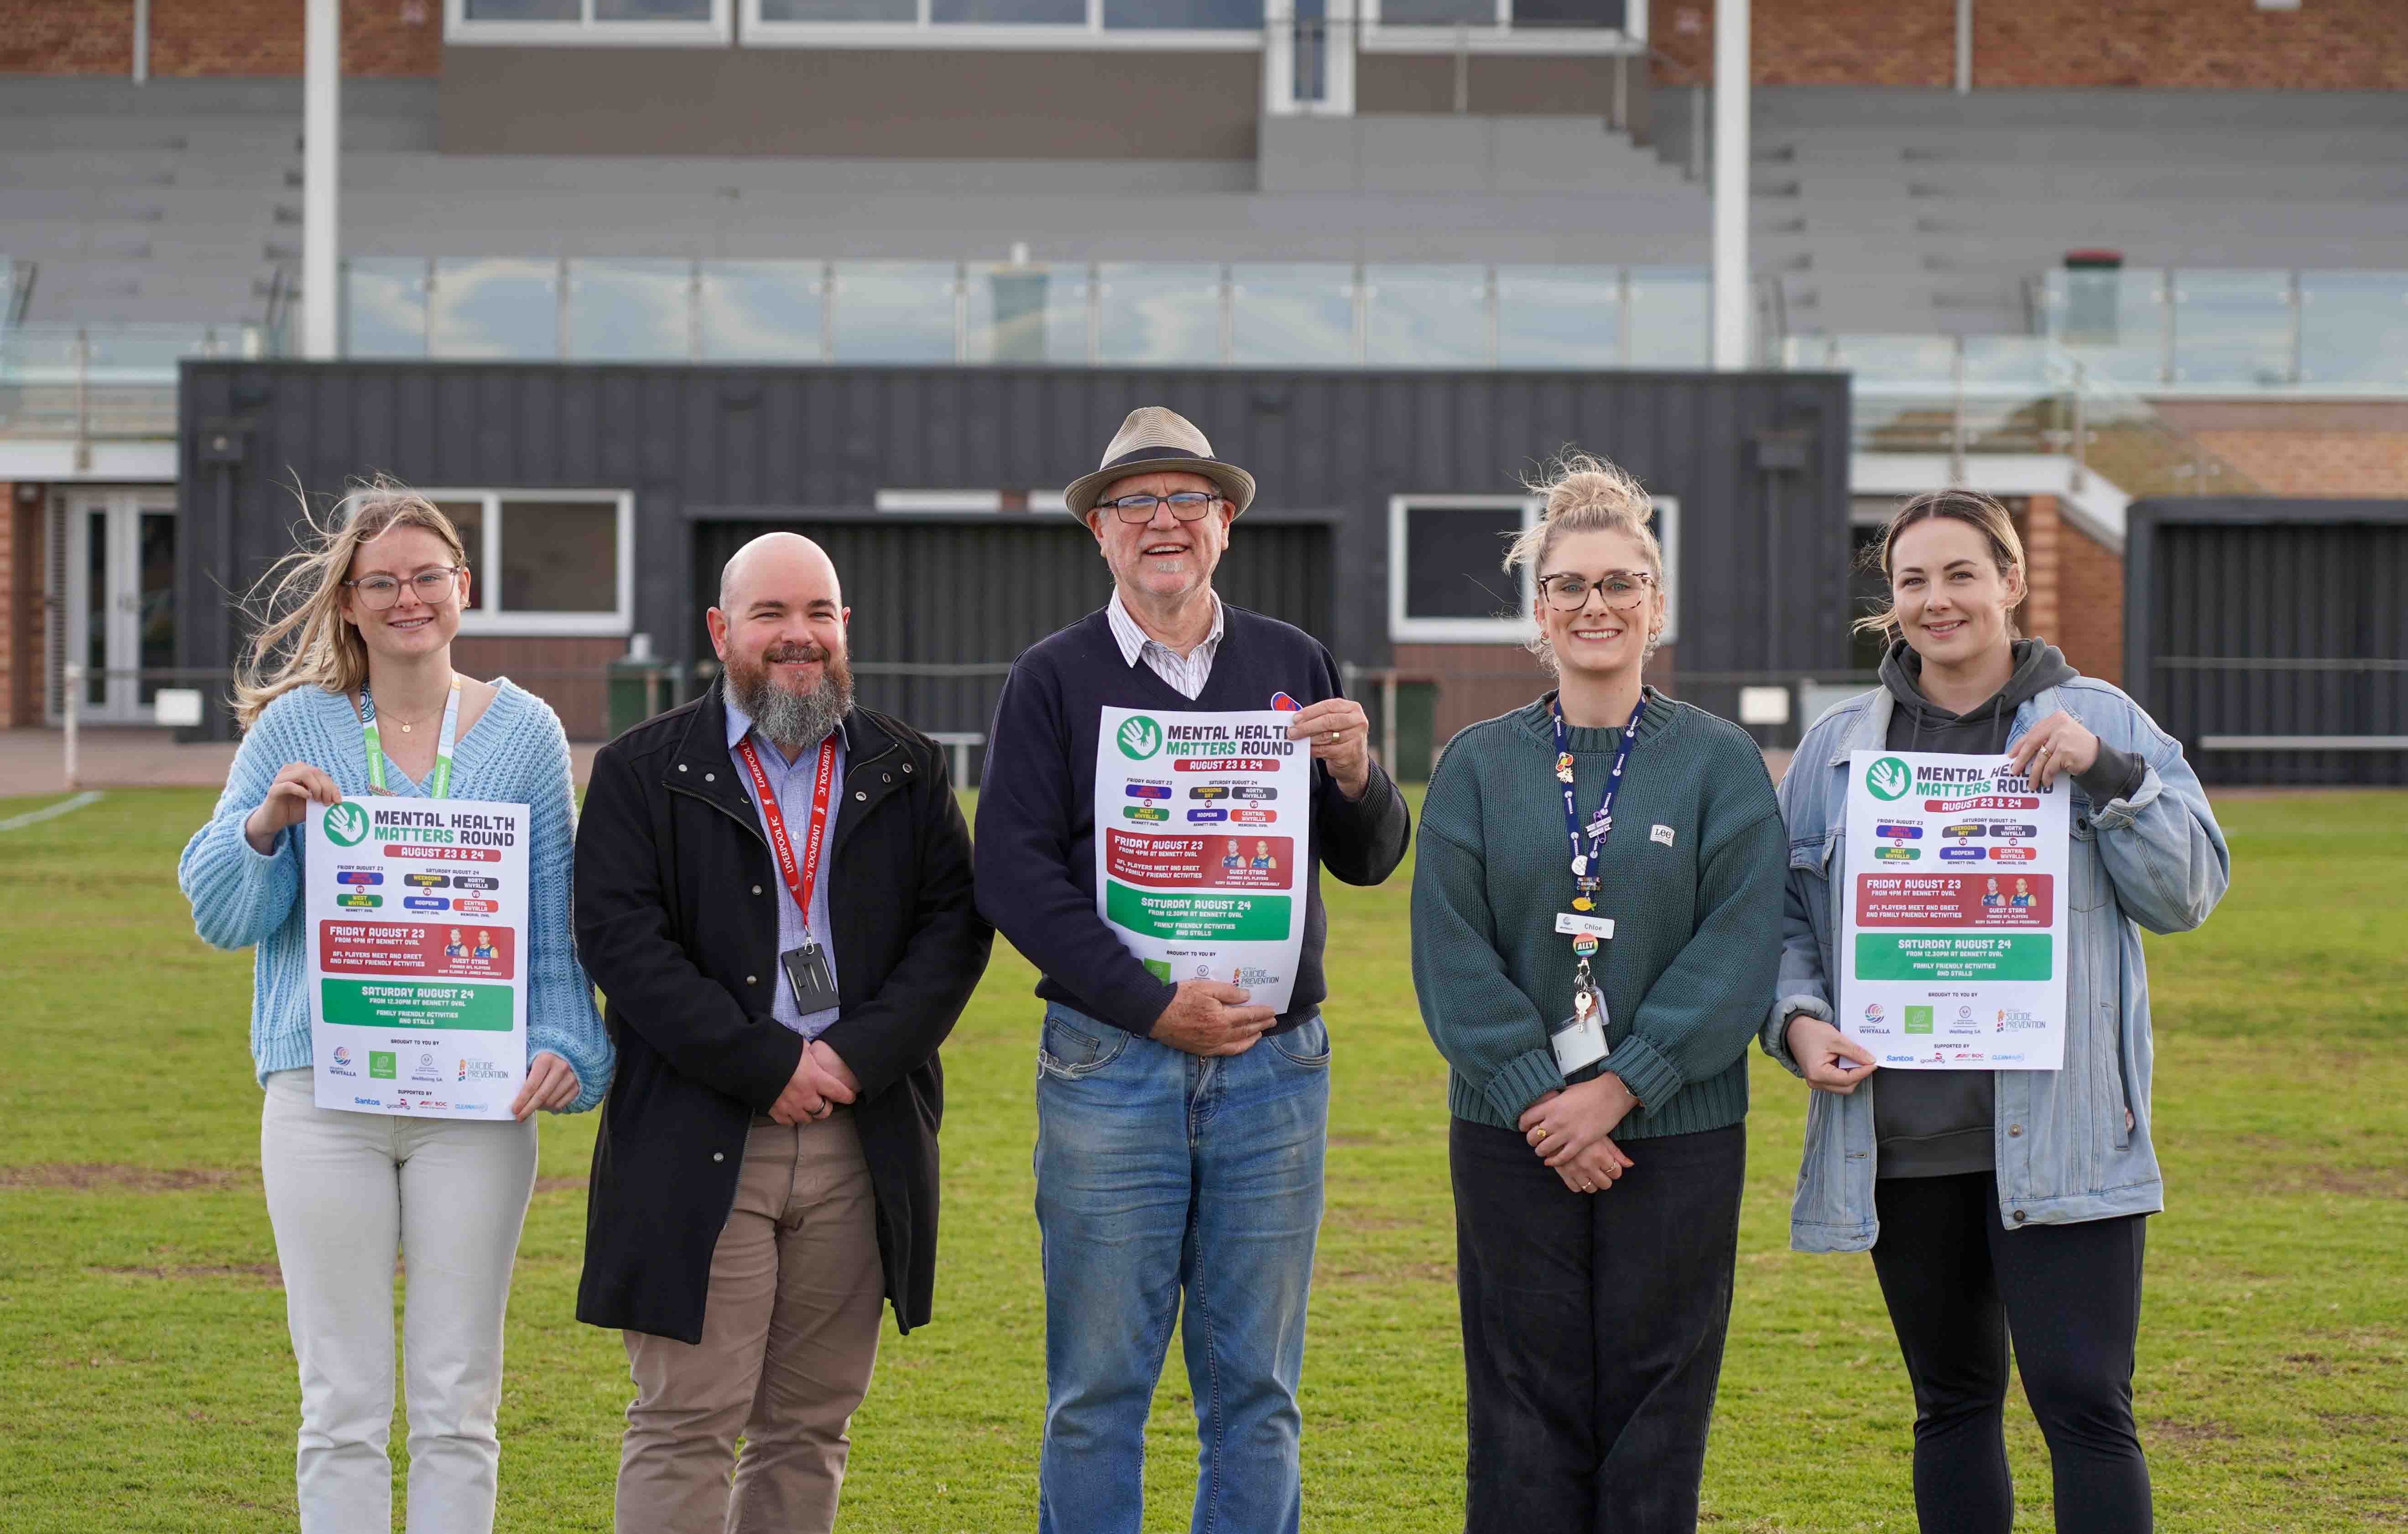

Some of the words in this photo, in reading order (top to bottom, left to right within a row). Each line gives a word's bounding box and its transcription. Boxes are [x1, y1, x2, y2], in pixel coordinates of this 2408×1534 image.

[1168, 725, 1229, 740] MENTAL
[1166, 741, 1235, 755] MATTERS
[1241, 741, 1293, 756] ROUND
[744, 747, 765, 788] LIVERPOOL
[820, 745, 832, 785] LIVERPOOL
[1190, 761, 1224, 770] AUGUST
[1226, 761, 1237, 769] 23
[1240, 761, 1246, 769] &
[1250, 760, 1262, 769] 24
[1917, 767, 1985, 782] MENTAL
[818, 786, 826, 796] FC
[1916, 781, 1991, 797] MATTERS
[1942, 799, 1978, 810] AUGUST
[1981, 798, 1993, 807] 23
[1997, 798, 2004, 807] &
[2008, 798, 2022, 807] 24
[375, 810, 444, 827] MENTAL
[452, 814, 514, 831] HEALTH
[771, 815, 780, 826] FC
[375, 827, 454, 843] MATTERS
[460, 831, 514, 846] ROUND
[1654, 828, 1671, 839] Lee
[808, 824, 821, 869] LIVERPOOL
[1115, 835, 1149, 849] FRIDAY
[1152, 840, 1188, 849] AUGUST
[1191, 841, 1203, 850] 23
[401, 847, 441, 858] AUGUST
[444, 849, 457, 858] 23
[460, 850, 468, 859] &
[471, 850, 484, 859] 24
[775, 827, 794, 874] LIVERPOOL
[1127, 861, 1152, 870] PLAYERS
[806, 871, 813, 882] FC
[1126, 867, 1145, 876] FAMILY
[1867, 880, 1902, 888] FRIDAY
[1905, 880, 1944, 888] AUGUST
[1948, 880, 1961, 888] 23
[1141, 897, 1191, 908] SATURDAY
[1194, 900, 1234, 910] AUGUST
[1237, 901, 1251, 910] 24
[330, 927, 365, 937] FRIDAY
[369, 928, 408, 938] AUGUST
[412, 929, 425, 938] 23
[1577, 941, 1594, 950] ALLY
[1898, 940, 1950, 949] SATURDAY
[1955, 940, 1994, 949] AUGUST
[1998, 940, 2011, 949] 24
[1241, 977, 1279, 985] PREVENTION
[362, 987, 413, 997] SATURDAY
[417, 989, 457, 998] AUGUST
[460, 990, 474, 998] 24
[355, 1096, 380, 1106] Santos
